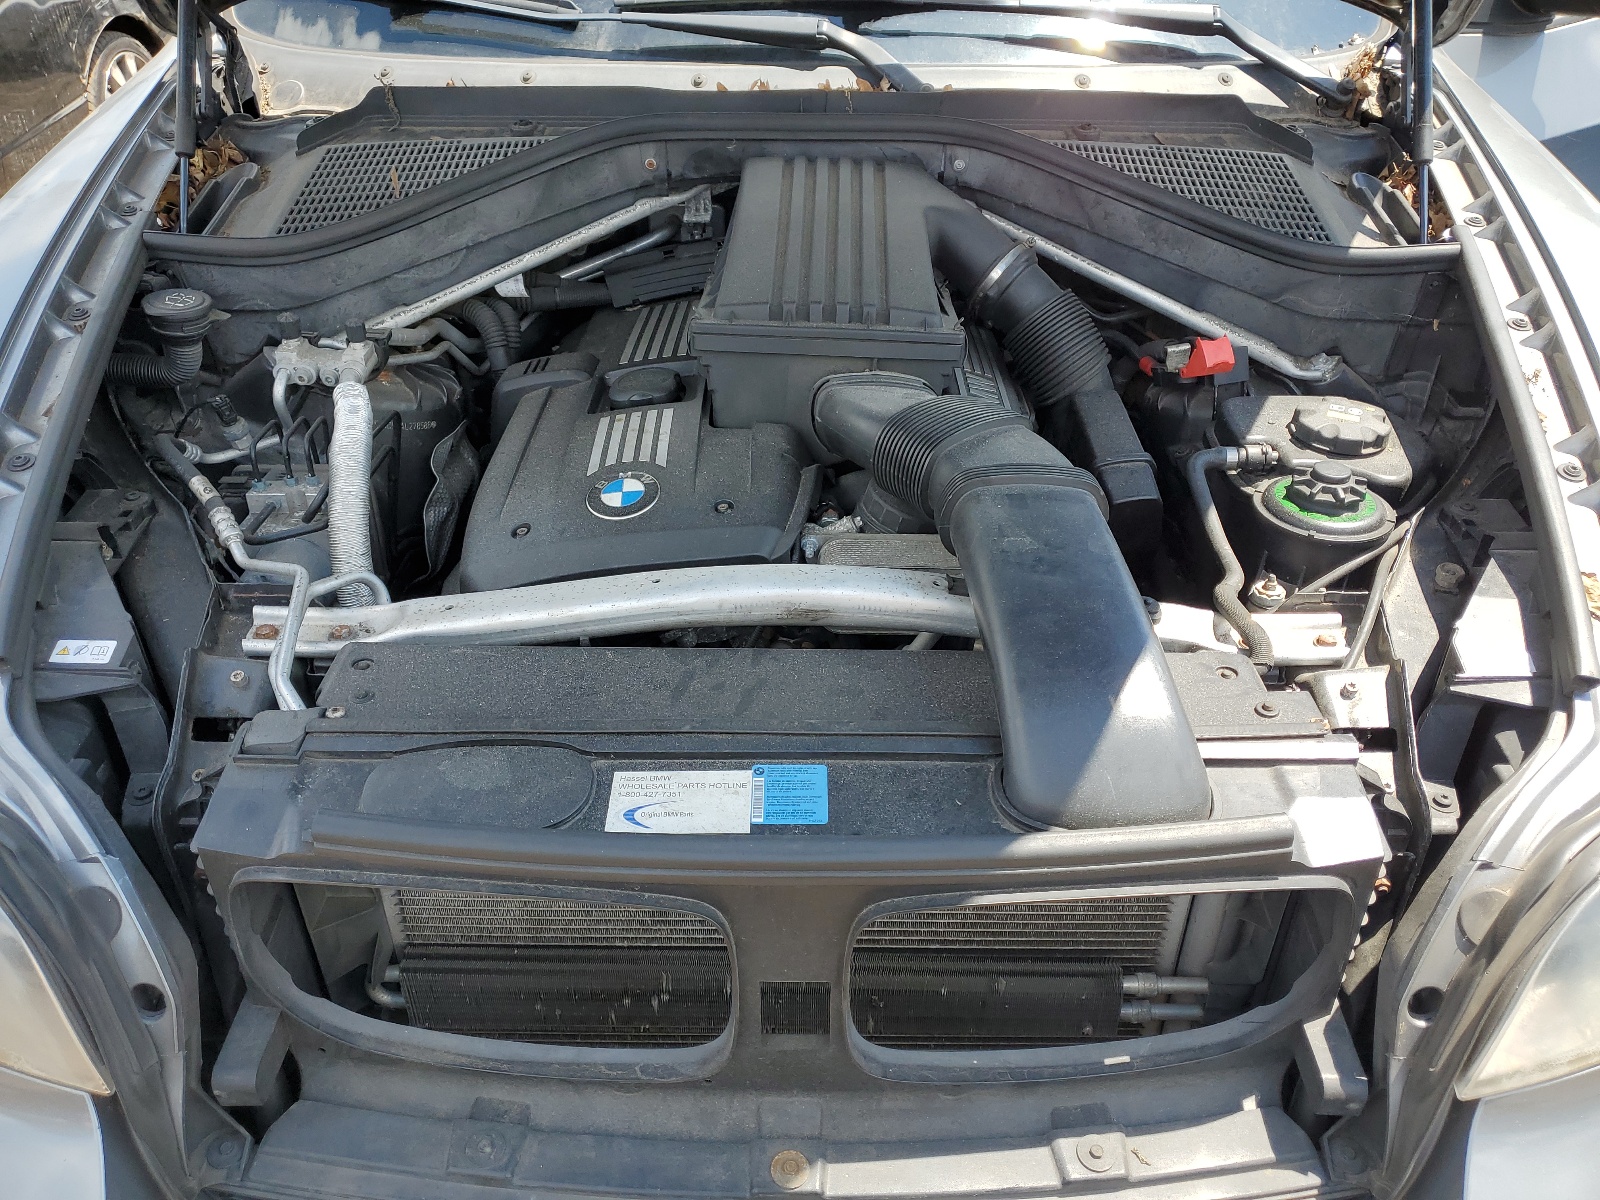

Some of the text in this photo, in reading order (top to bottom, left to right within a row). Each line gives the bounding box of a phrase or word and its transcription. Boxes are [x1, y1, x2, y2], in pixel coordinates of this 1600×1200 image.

[594, 471, 656, 489] BMW
[677, 782, 707, 790] PARTS
[640, 811, 663, 819] Original
